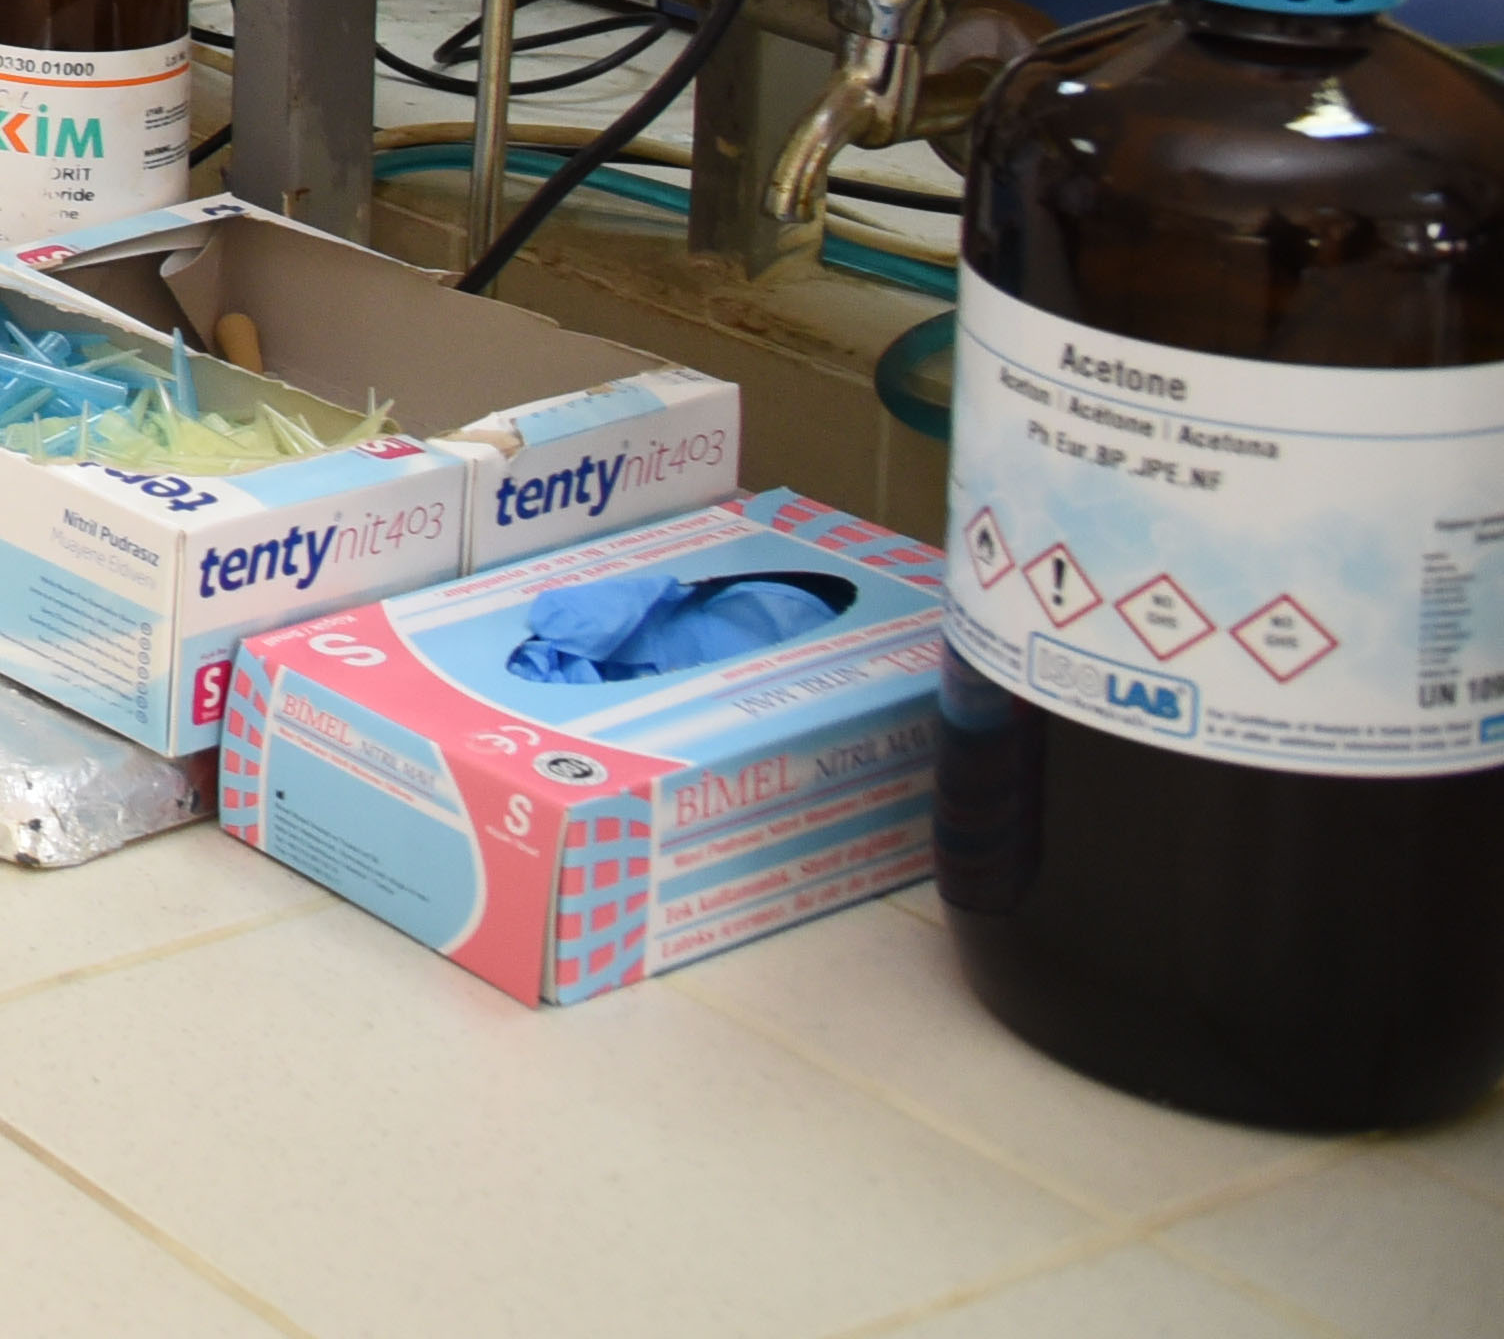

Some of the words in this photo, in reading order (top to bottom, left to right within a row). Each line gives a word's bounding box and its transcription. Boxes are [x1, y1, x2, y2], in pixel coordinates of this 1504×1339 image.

[1058, 342, 1188, 402] Acetone
[308, 632, 387, 668] S
[503, 794, 534, 837] S
[675, 753, 797, 828] BİMEL
